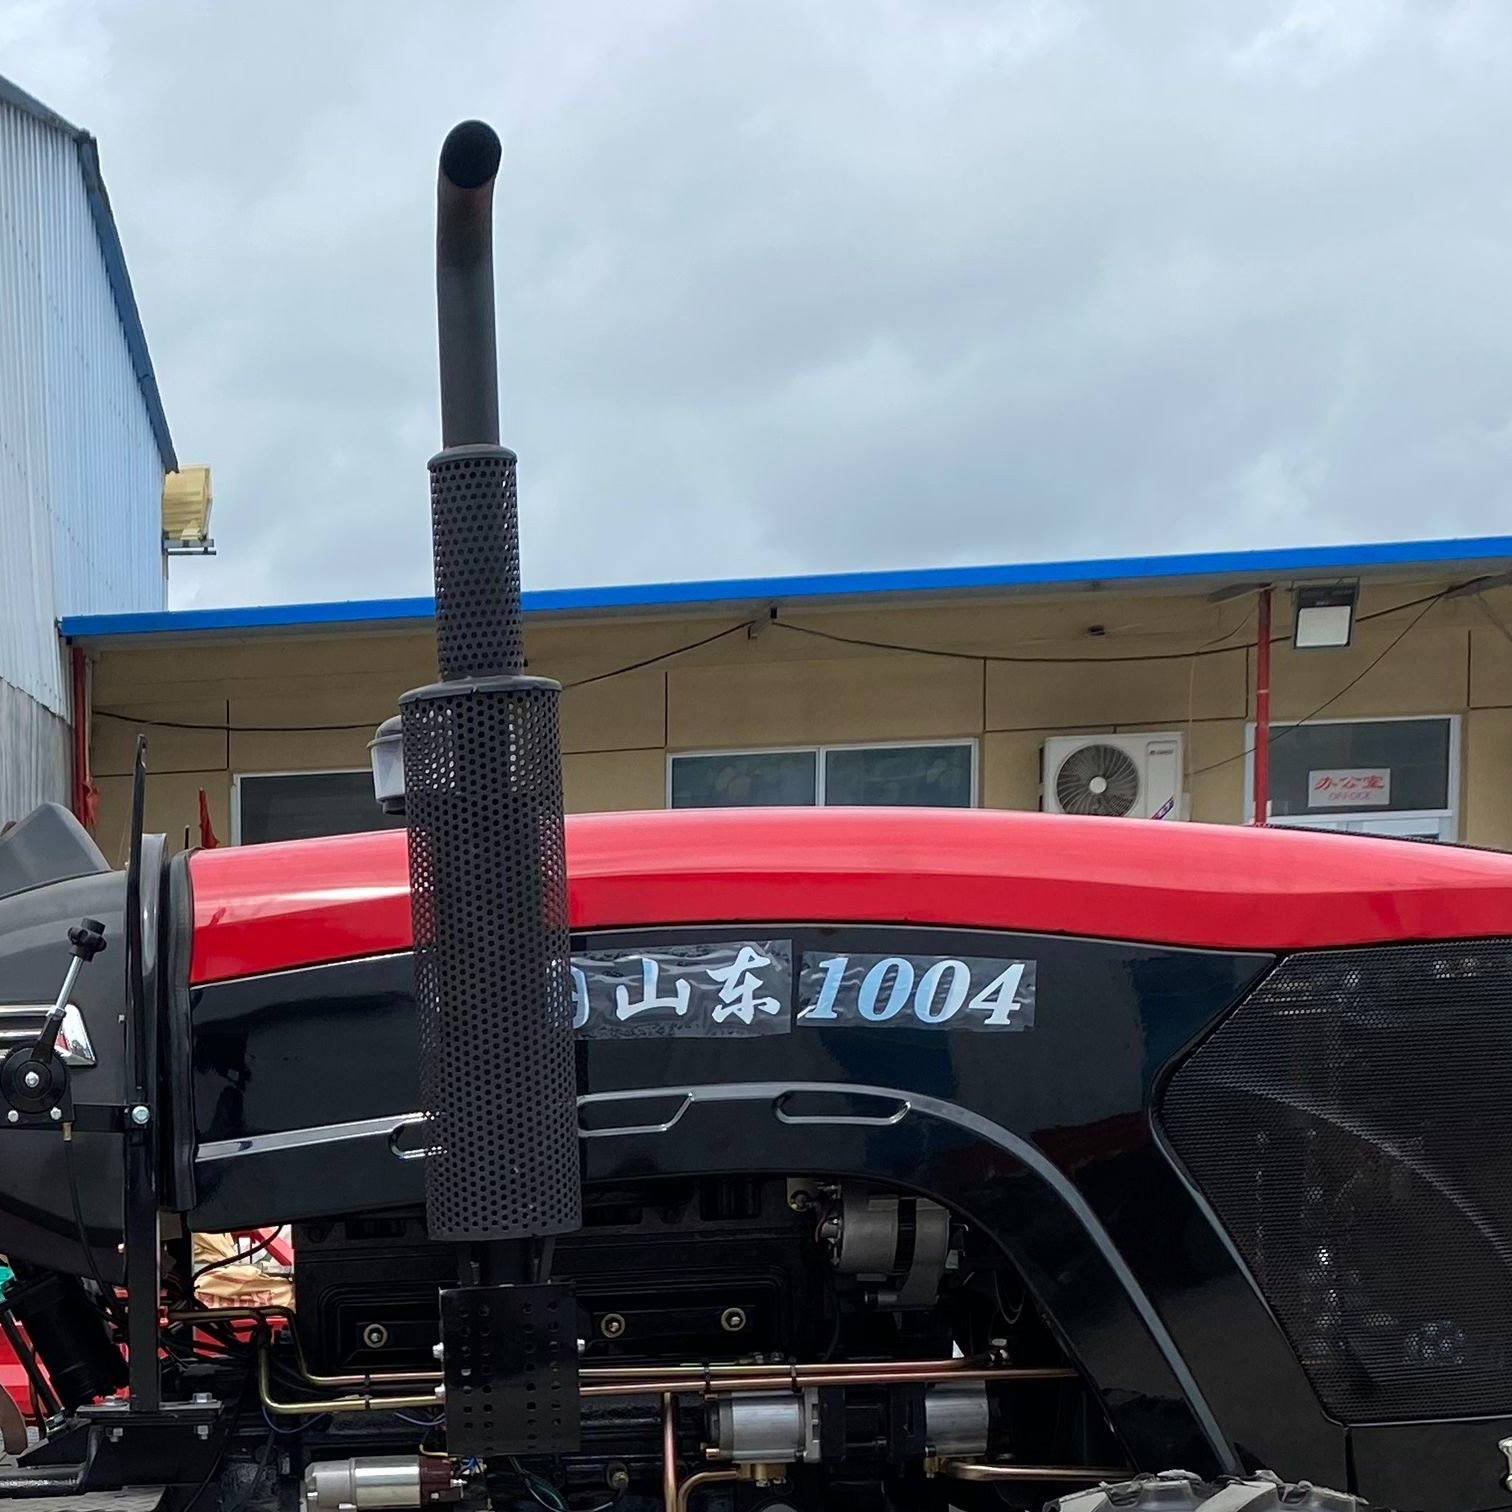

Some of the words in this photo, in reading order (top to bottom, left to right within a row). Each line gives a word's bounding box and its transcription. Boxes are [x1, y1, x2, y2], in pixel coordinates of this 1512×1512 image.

[1313, 774, 1385, 791] 办公室
[614, 945, 782, 1025] 山东
[804, 957, 1026, 1026] 1004
